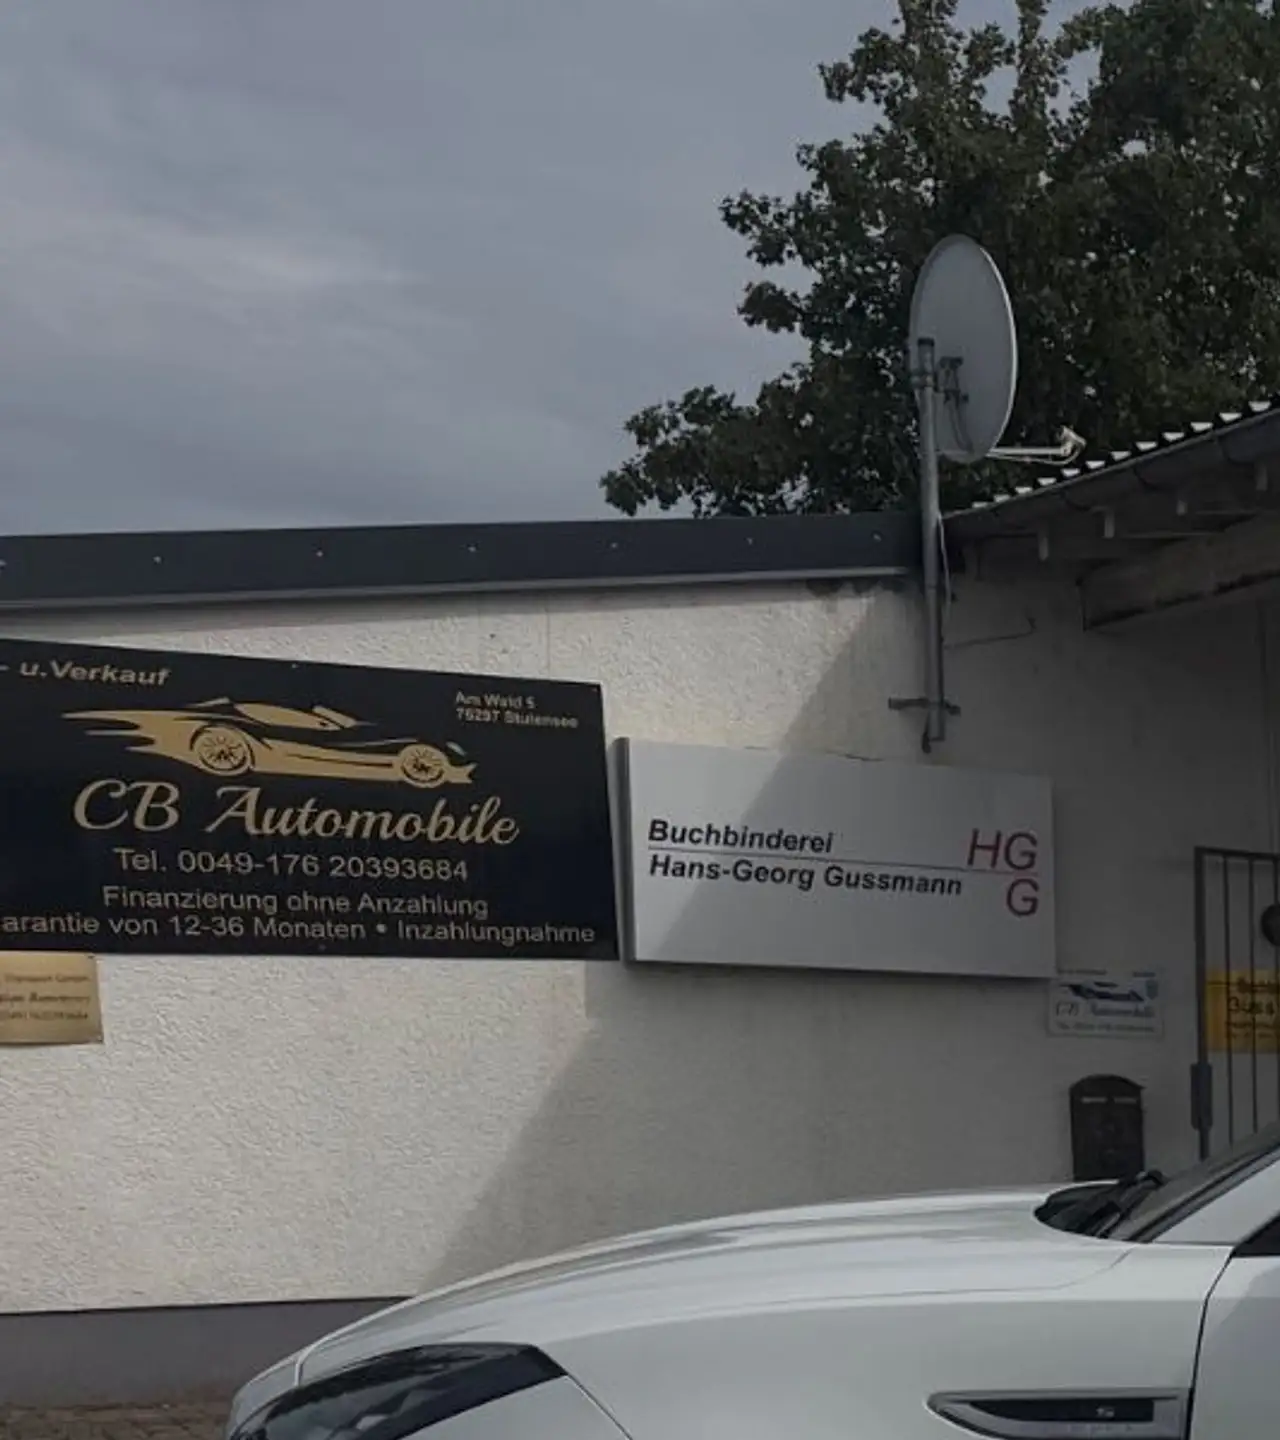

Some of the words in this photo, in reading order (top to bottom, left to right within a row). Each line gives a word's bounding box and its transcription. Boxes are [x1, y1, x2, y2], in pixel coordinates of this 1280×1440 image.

[73, 778, 181, 832] CB
[204, 786, 520, 845] Automobile
[648, 818, 835, 853] Buchbinderei
[966, 827, 1038, 871] HG
[113, 847, 167, 872] Tel.
[177, 849, 320, 877] 0049-176
[329, 855, 469, 882] 20393684
[649, 853, 815, 892] Hans-Georg
[823, 864, 963, 897] Gussmann
[102, 884, 278, 915] Finanzierung
[287, 890, 350, 914] ohne
[357, 892, 489, 921] Anzahlung
[1006, 877, 1040, 918] G
[0, 912, 100, 935] arantie
[108, 917, 158, 936] von
[169, 914, 245, 938] 12-36
[253, 916, 367, 940] Monaten
[398, 919, 596, 948] Inzahlungnahme
